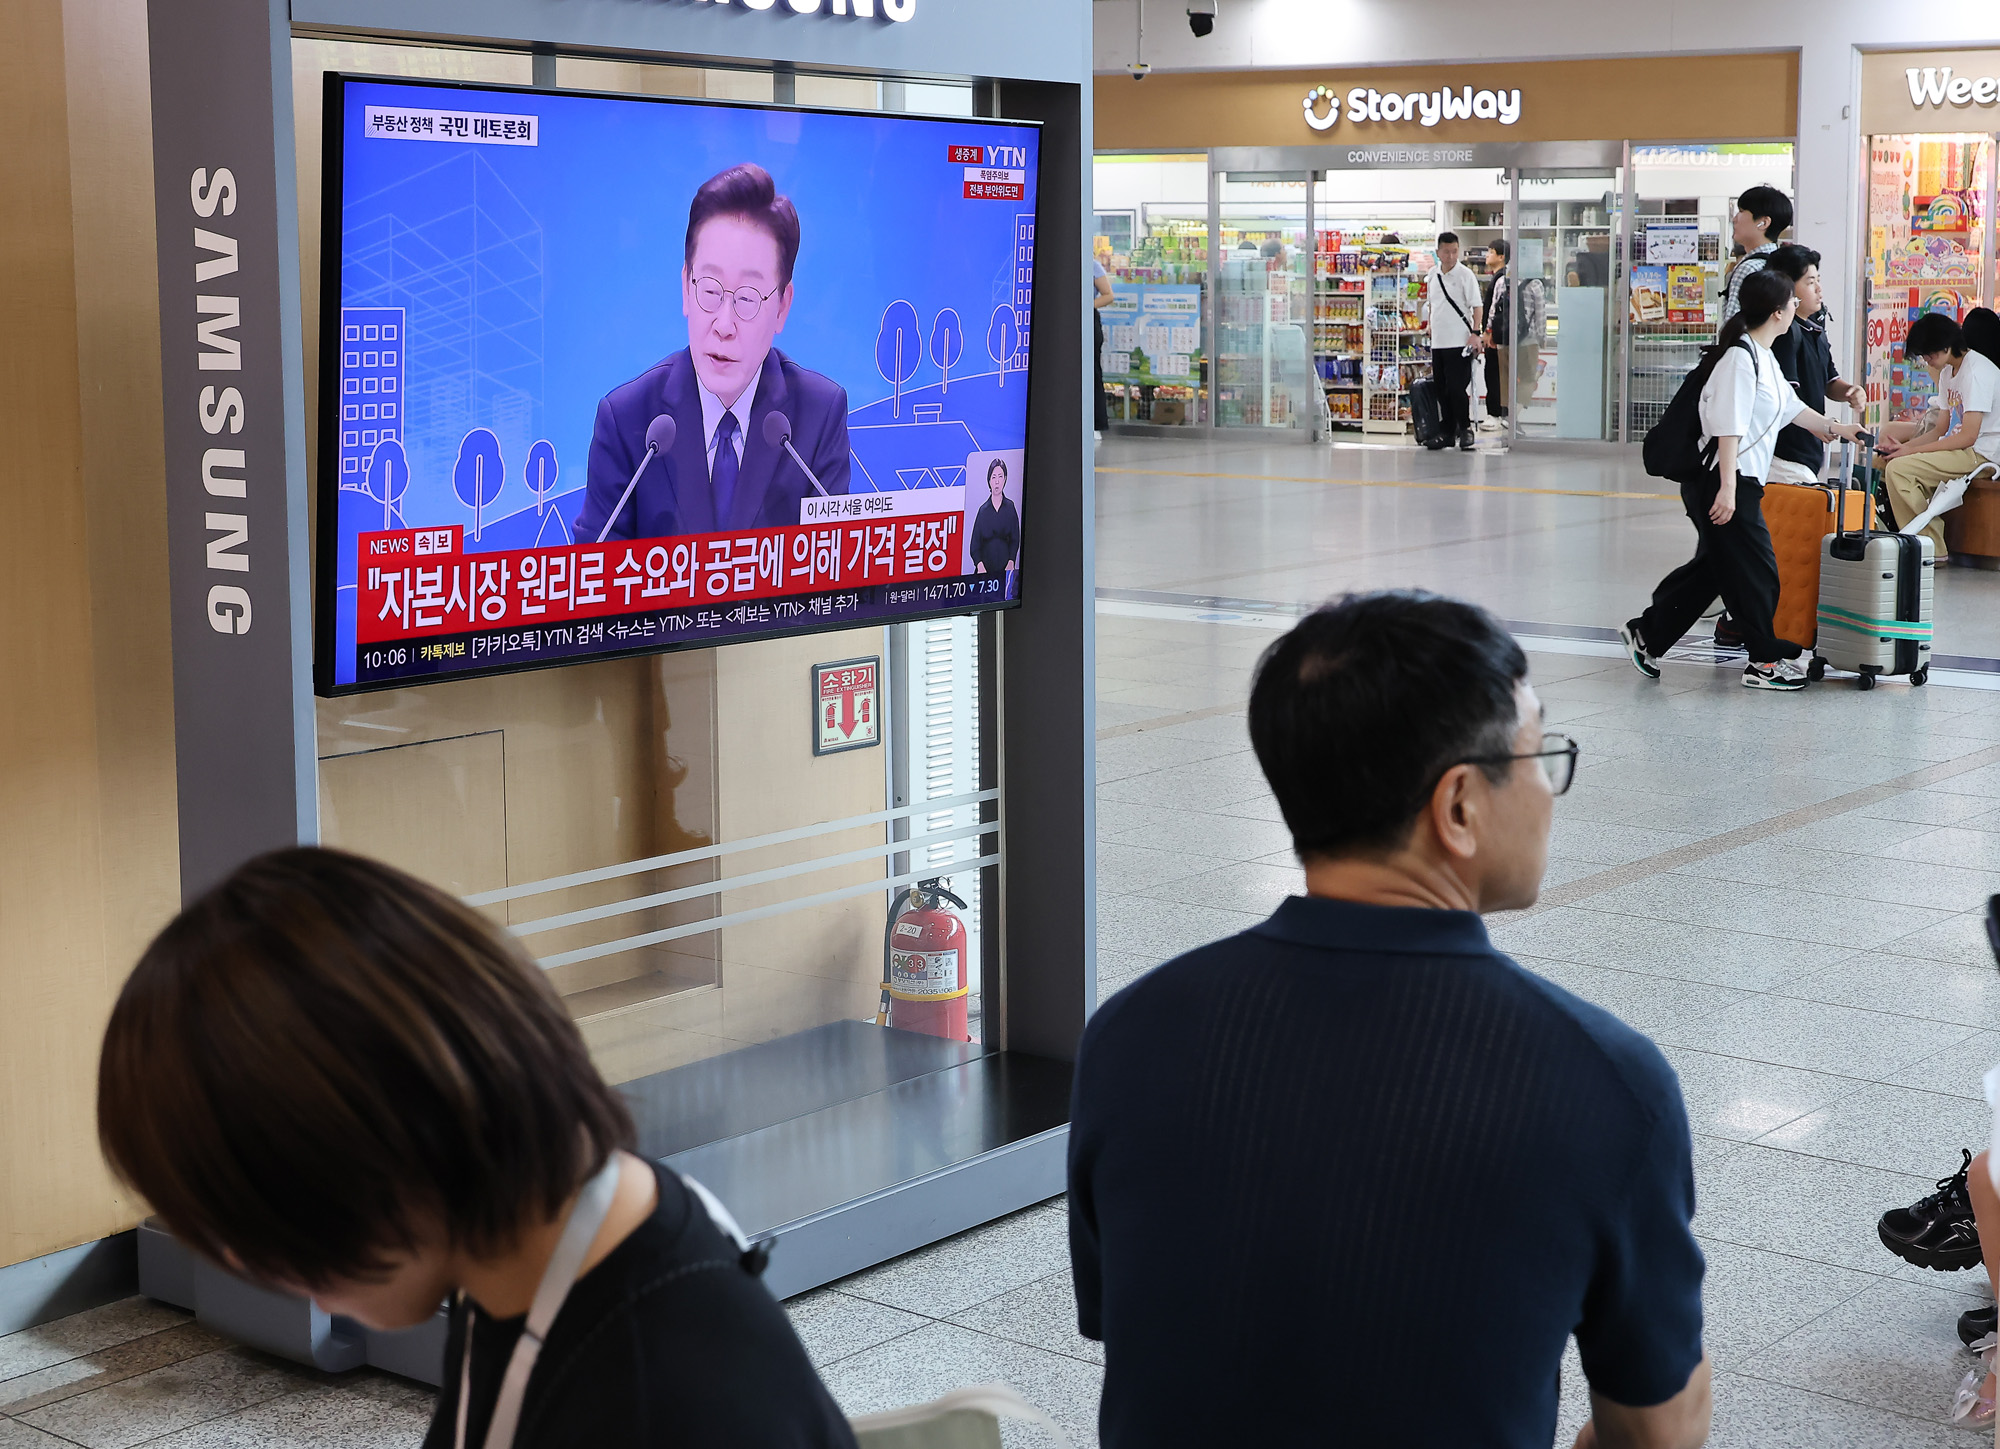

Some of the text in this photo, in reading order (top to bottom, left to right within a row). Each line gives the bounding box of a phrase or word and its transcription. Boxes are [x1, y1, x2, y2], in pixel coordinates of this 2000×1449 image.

[1905, 66, 2000, 107] Wee
[1346, 85, 1522, 127] StoryWay
[373, 114, 531, 140] 부동산 정책 국민 대토론회
[954, 147, 978, 161] 생중계
[986, 145, 1026, 167] YTN
[1347, 150, 1473, 163] CONVENIENCE STORE
[980, 170, 1010, 181] 폭염주의보
[969, 184, 983, 197] 전북
[190, 167, 253, 635] SAMSUNG
[807, 496, 894, 519] 이 시각 서울 여의도
[370, 532, 450, 555] NEWS 속보
[367, 515, 957, 630] "자본시장 원리로 수요와 공급에 의해 가격 결정"
[363, 648, 407, 669] 10:06
[420, 642, 466, 661] 카톡제보
[472, 630, 541, 659] [카카오톡]
[544, 630, 573, 646] YTN
[576, 622, 603, 645] 검색
[607, 618, 656, 640] <뉴스는
[659, 614, 694, 633] YTN>
[696, 611, 723, 629] 또는
[725, 604, 771, 625] <제보는
[773, 602, 806, 619] YTN>
[808, 595, 832, 616] 채널
[834, 593, 859, 614] 추가
[923, 581, 966, 601] 1471.70
[978, 579, 999, 594] 7.30
[823, 667, 872, 689] 소화기
[899, 925, 917, 935] 2-20
